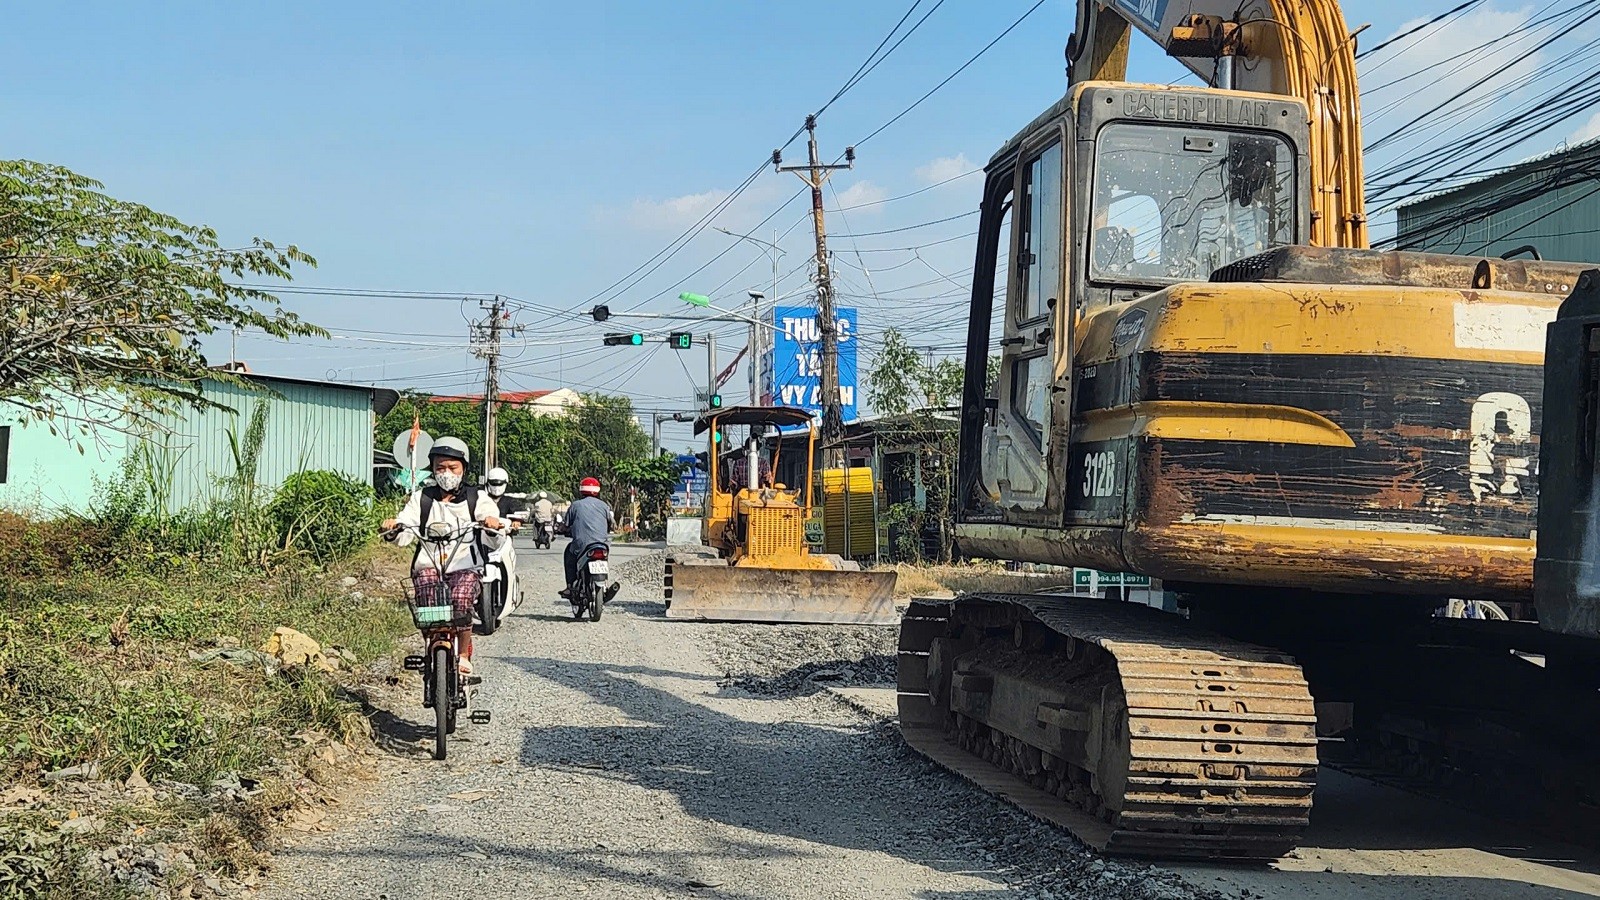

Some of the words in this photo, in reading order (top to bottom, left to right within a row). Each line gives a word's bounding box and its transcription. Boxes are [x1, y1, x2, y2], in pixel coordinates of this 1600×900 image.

[1122, 91, 1269, 127] CATERPILLAR
[782, 311, 851, 342] THUC
[780, 384, 806, 406] VY
[1083, 450, 1116, 498] 312B
